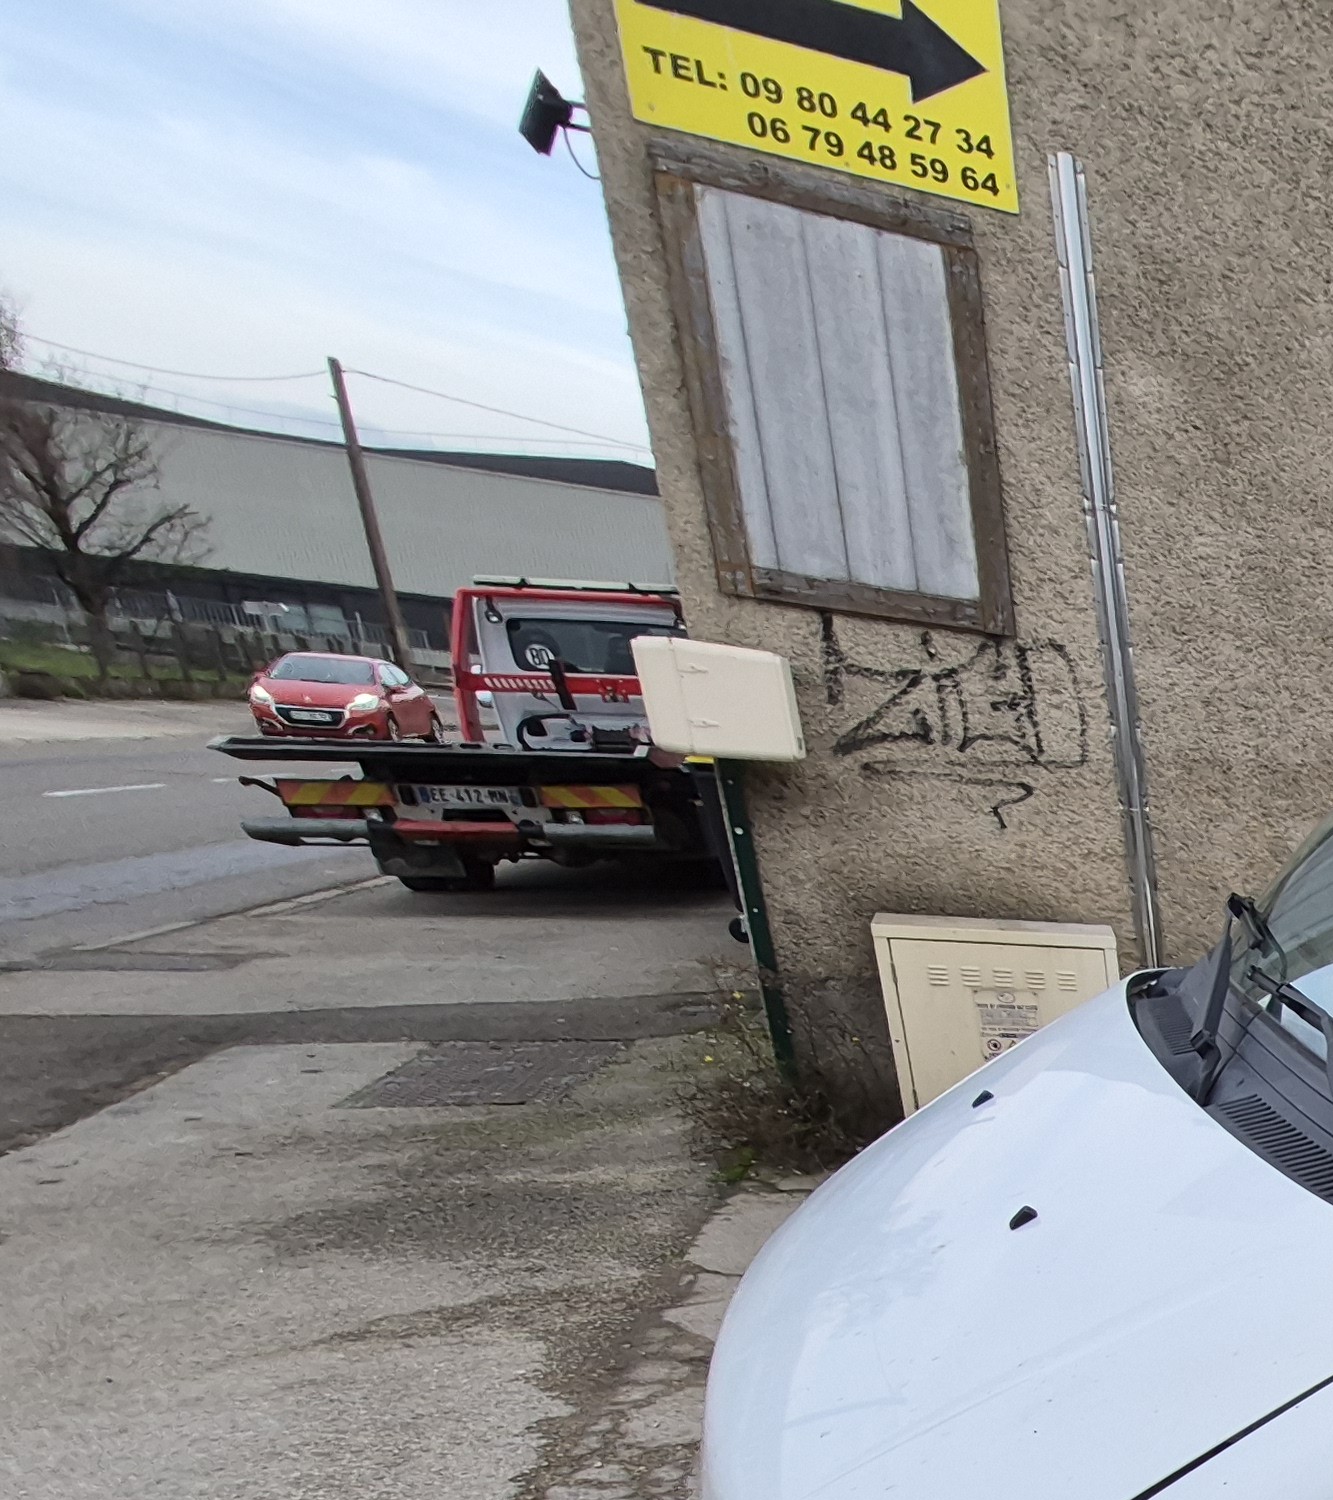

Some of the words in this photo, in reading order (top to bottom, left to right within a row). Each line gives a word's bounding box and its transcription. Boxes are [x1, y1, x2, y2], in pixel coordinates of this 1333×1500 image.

[641, 45, 728, 90] TEL:
[740, 72, 784, 105] 09
[795, 86, 838, 119] 80
[850, 101, 892, 133] 44
[903, 114, 941, 145] 27
[954, 127, 995, 159] 34
[746, 111, 791, 144] 06
[801, 124, 845, 158] 79
[856, 140, 897, 171] 48
[909, 152, 949, 184] 59
[960, 166, 1000, 197] 64
